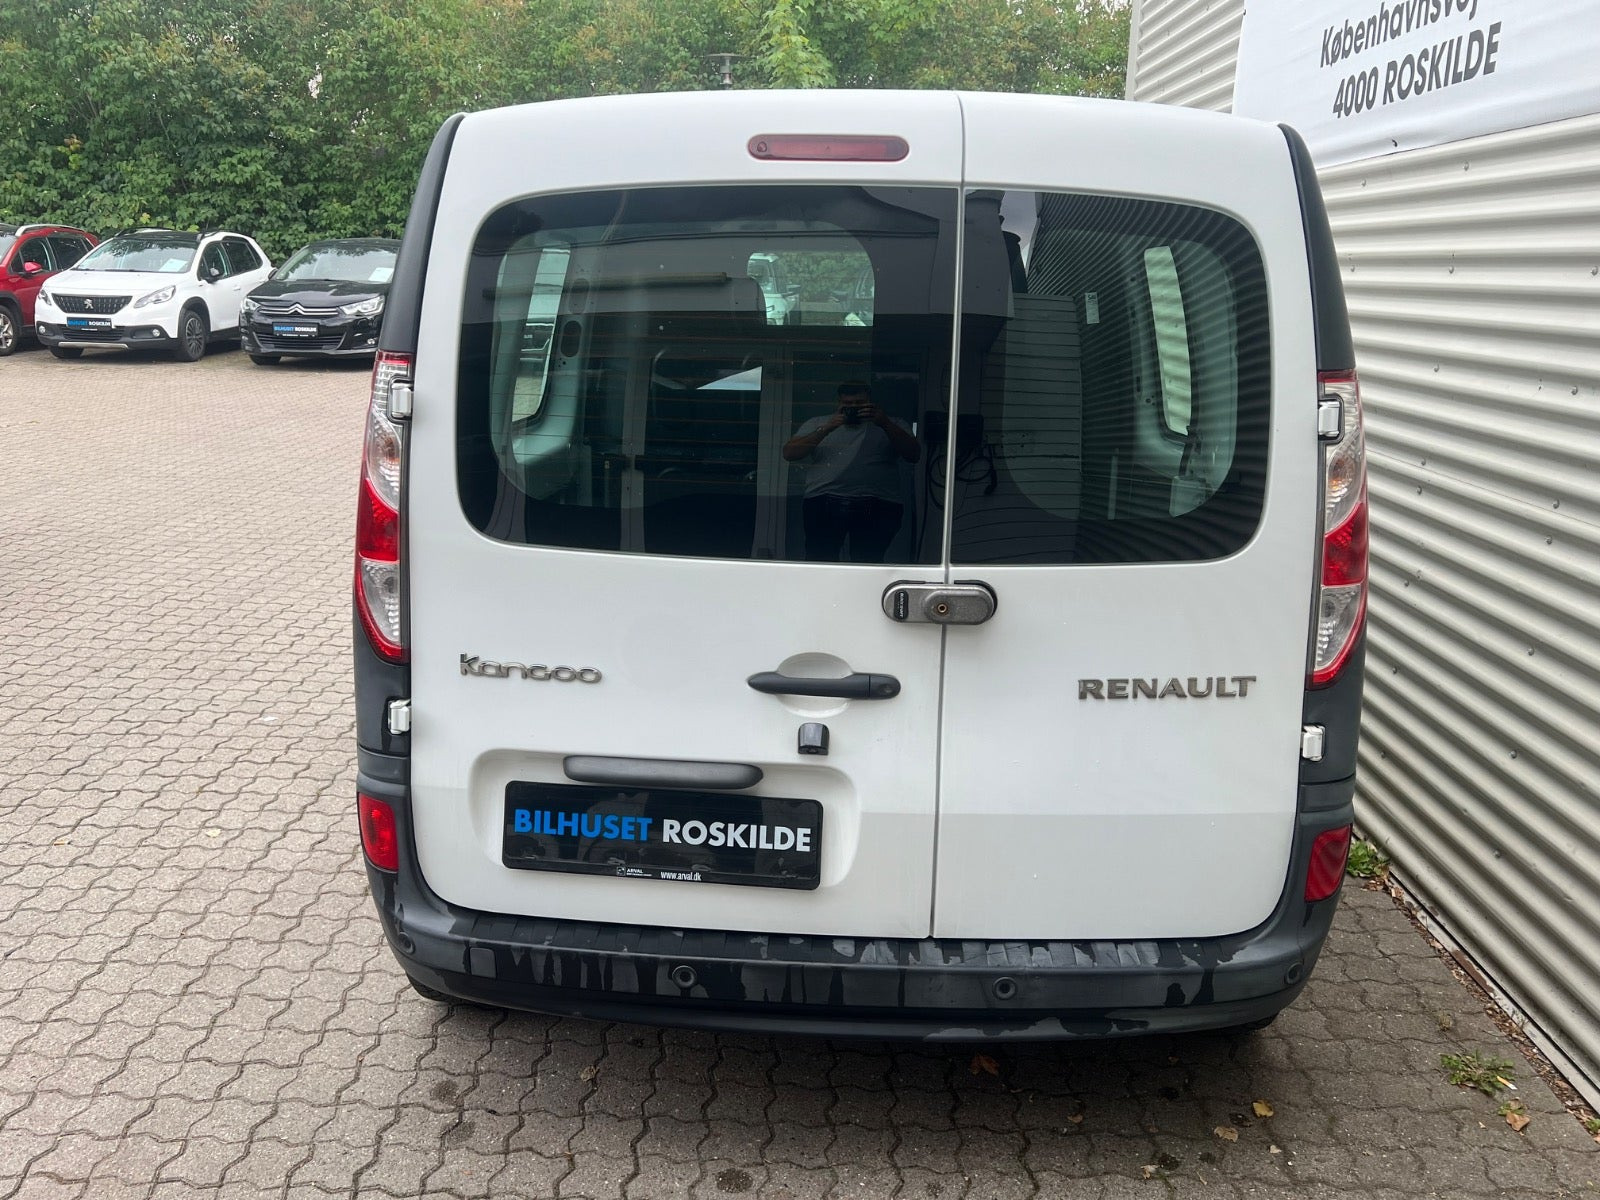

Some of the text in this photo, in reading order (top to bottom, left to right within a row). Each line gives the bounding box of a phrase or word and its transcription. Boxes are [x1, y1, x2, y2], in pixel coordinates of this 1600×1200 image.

[1333, 22, 1501, 118] 4000 ROSKILDE
[1078, 676, 1256, 700] RENAULT
[514, 809, 811, 852] BILHUSET ROSKILDE
[660, 871, 702, 881] www.arval.dk
